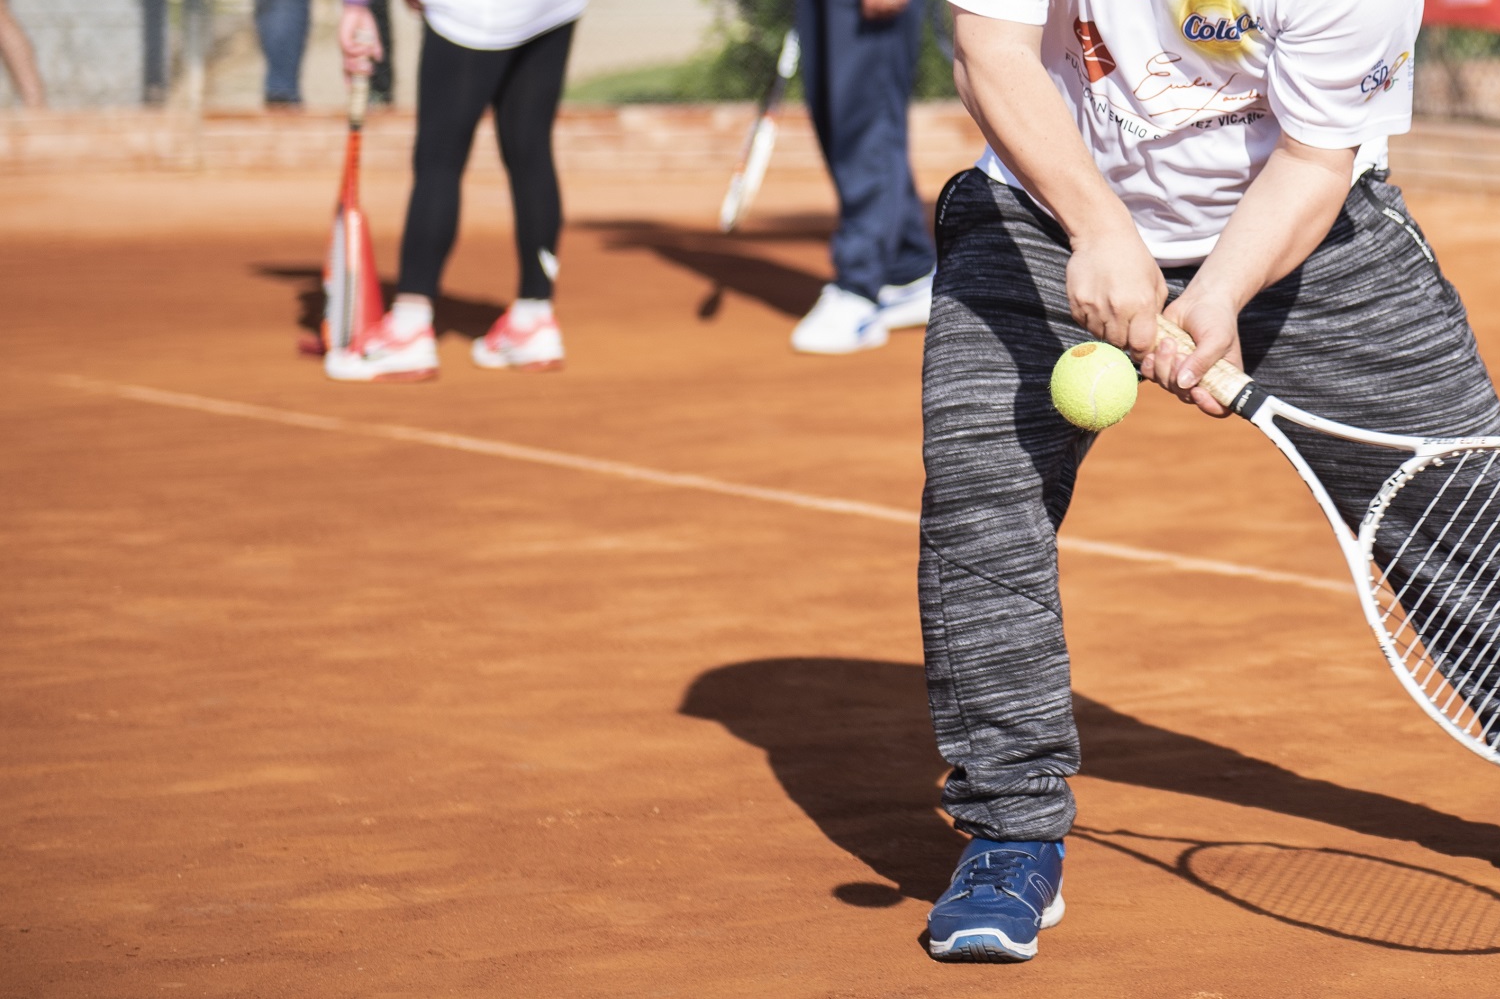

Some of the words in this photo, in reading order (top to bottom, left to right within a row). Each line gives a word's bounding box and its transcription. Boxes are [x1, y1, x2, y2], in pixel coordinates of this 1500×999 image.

[1182, 12, 1265, 43] ColaCa
[1361, 65, 1389, 93] CSD
[1109, 110, 1148, 139] EMILIO
